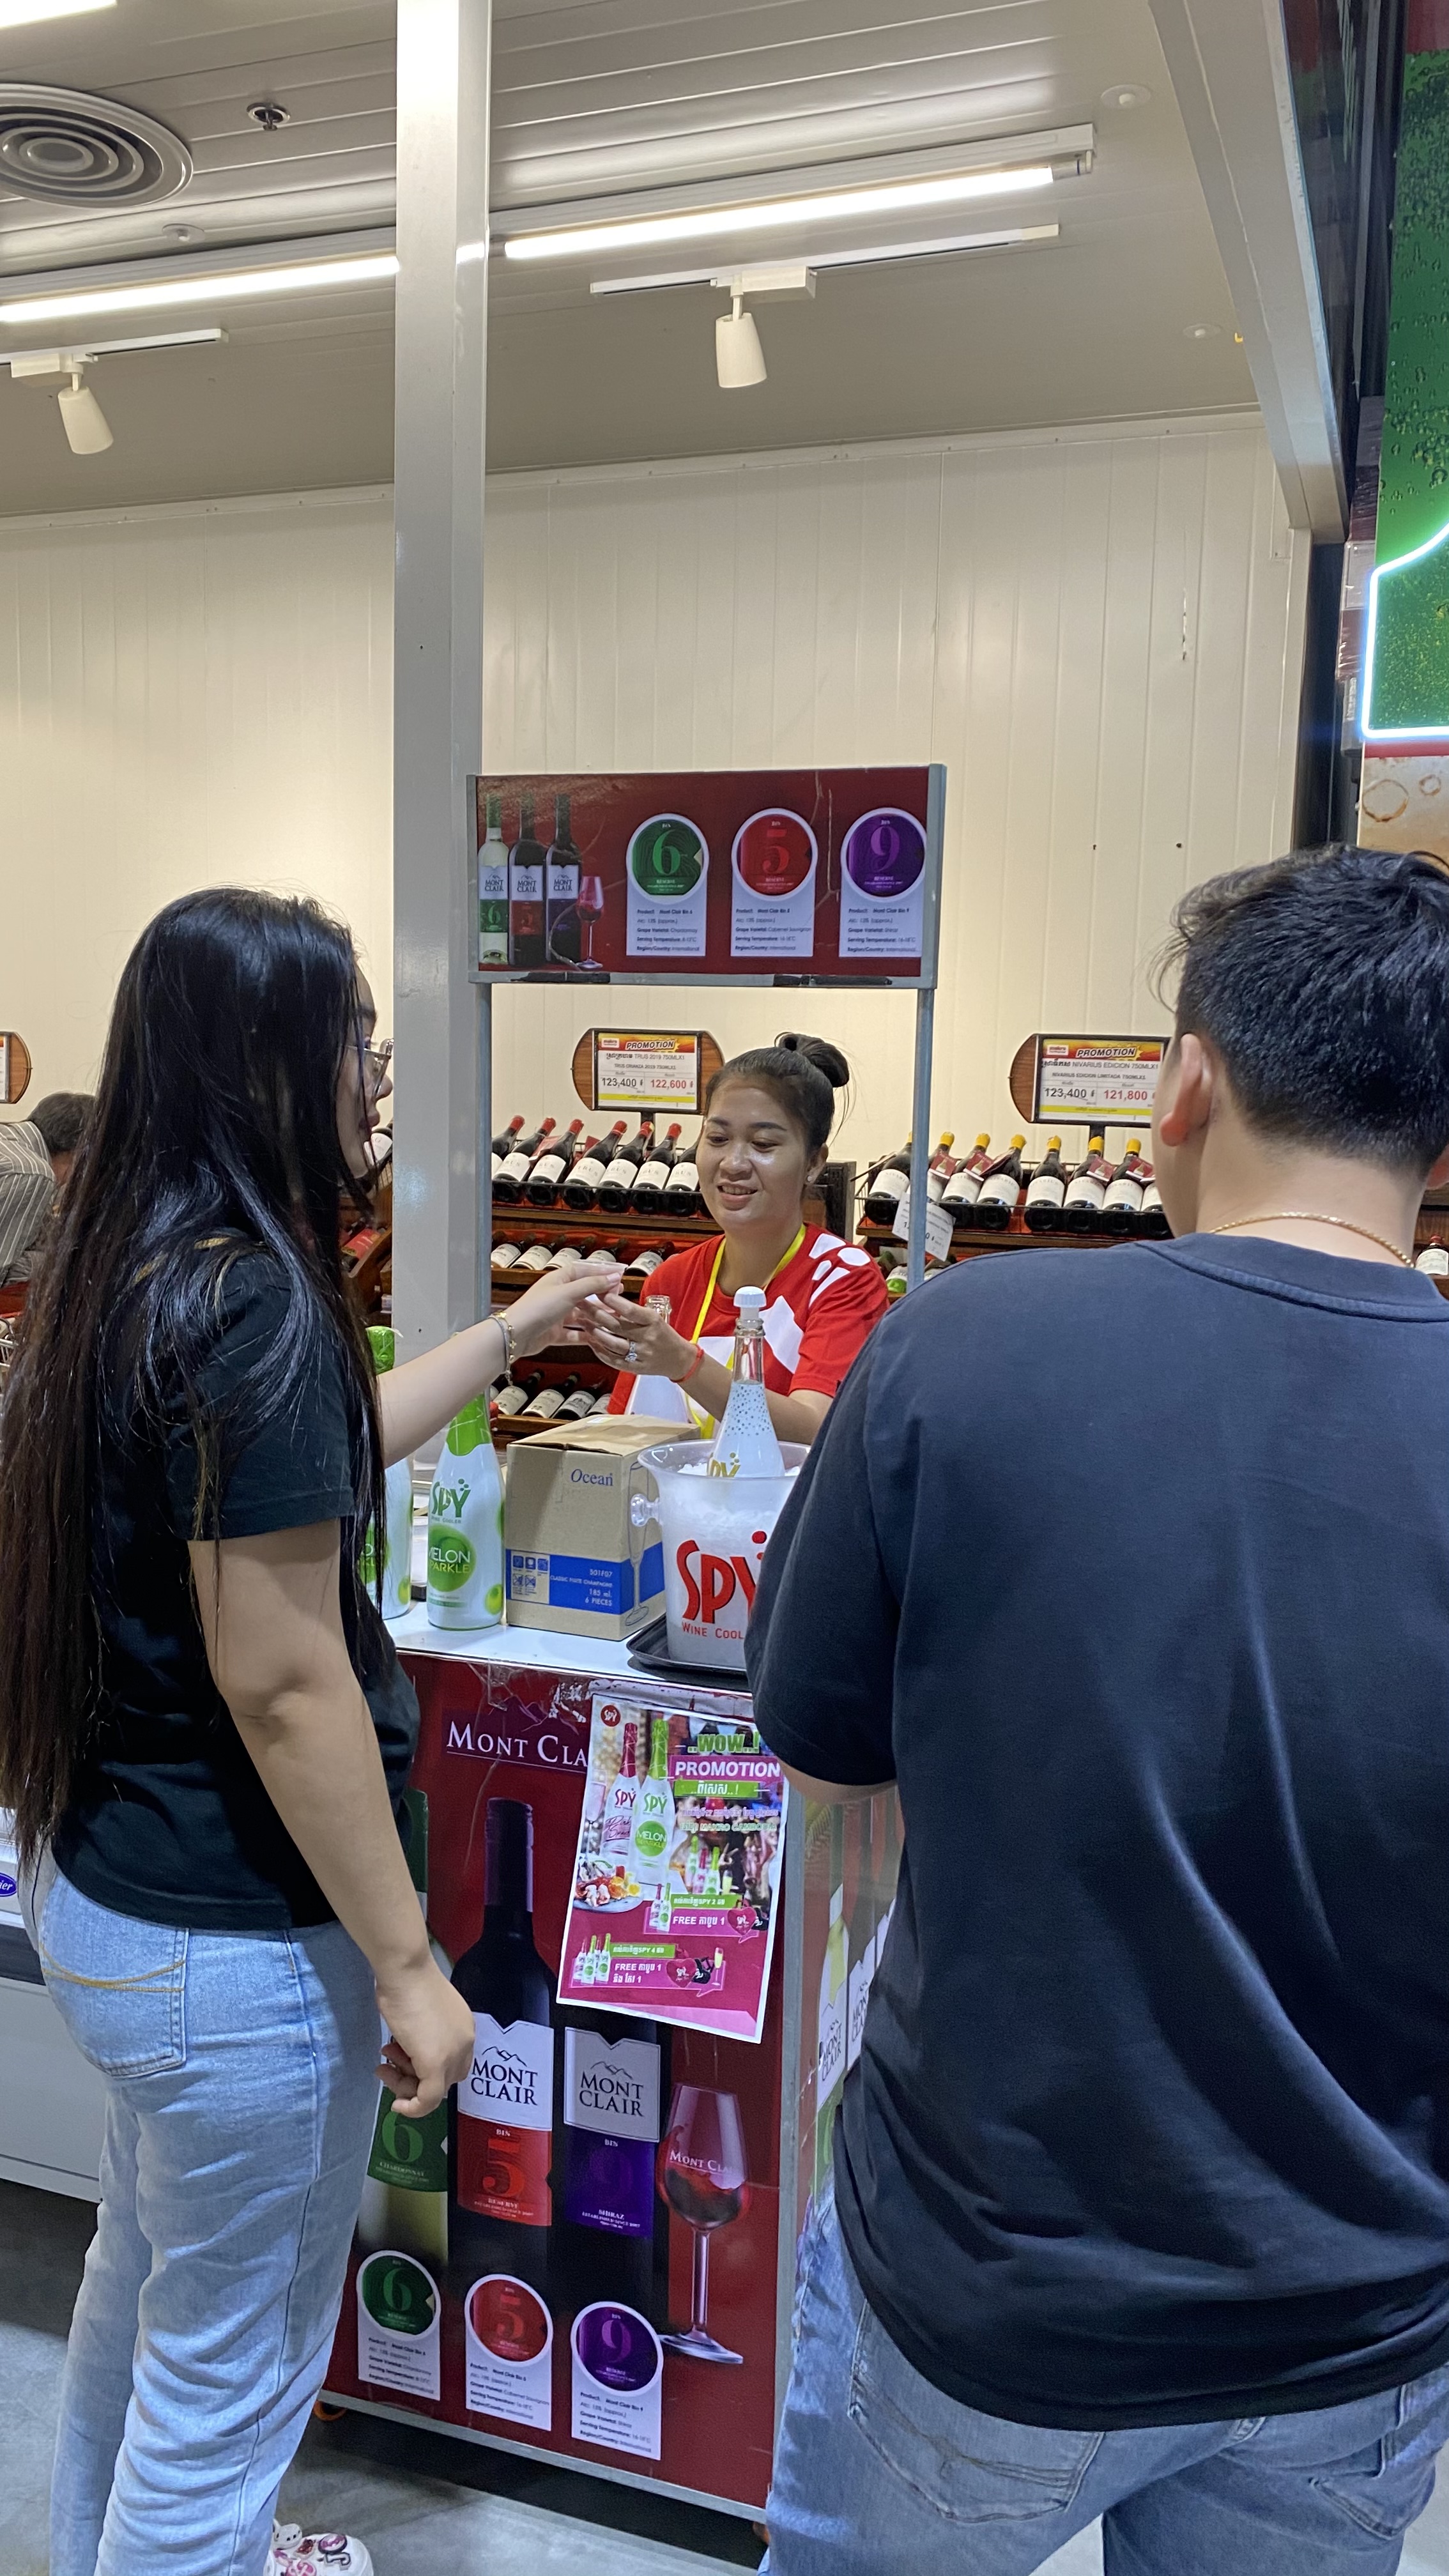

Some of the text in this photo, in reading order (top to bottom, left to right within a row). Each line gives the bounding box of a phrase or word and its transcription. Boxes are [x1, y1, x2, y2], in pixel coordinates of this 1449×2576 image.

[652, 829, 681, 876] 6
[762, 829, 790, 875] 5
[870, 825, 900, 873] 9
[626, 1041, 675, 1049] PROMOTION
[1077, 1047, 1136, 1057] PROMOTION
[601, 1078, 636, 1088] 123,400
[650, 1079, 687, 1090] 122,600
[1045, 1087, 1087, 1100] 123,400
[1104, 1090, 1148, 1102] 121,800
[571, 1468, 614, 1486] Ocean
[431, 1480, 471, 1518] SPY
[429, 1561, 471, 1574] PARKLE
[676, 1539, 758, 1624] SPY
[588, 1588, 602, 1597] 185
[591, 1597, 613, 1607] PIECES
[681, 1621, 745, 1640] WINE COOL
[446, 1721, 588, 1768] MONT CLA
[675, 1761, 781, 1777] PROMOTION
[615, 1788, 637, 1808] SPY
[643, 1793, 668, 1814] SPY
[636, 1830, 667, 1843] MELON
[673, 1916, 697, 1925] FREE
[614, 1963, 637, 1972] FREE
[657, 1963, 662, 1972] 1
[471, 2057, 539, 2087] MONT
[470, 2077, 539, 2106] CLAIR
[580, 2070, 645, 2101] MONT
[579, 2090, 645, 2118] CLAIR
[496, 2128, 511, 2137] BIN
[604, 2138, 619, 2148] BIN
[482, 2137, 526, 2198] 5
[670, 2149, 705, 2168] MONT
[383, 2268, 412, 2312] 6
[601, 2319, 632, 2363] 9
